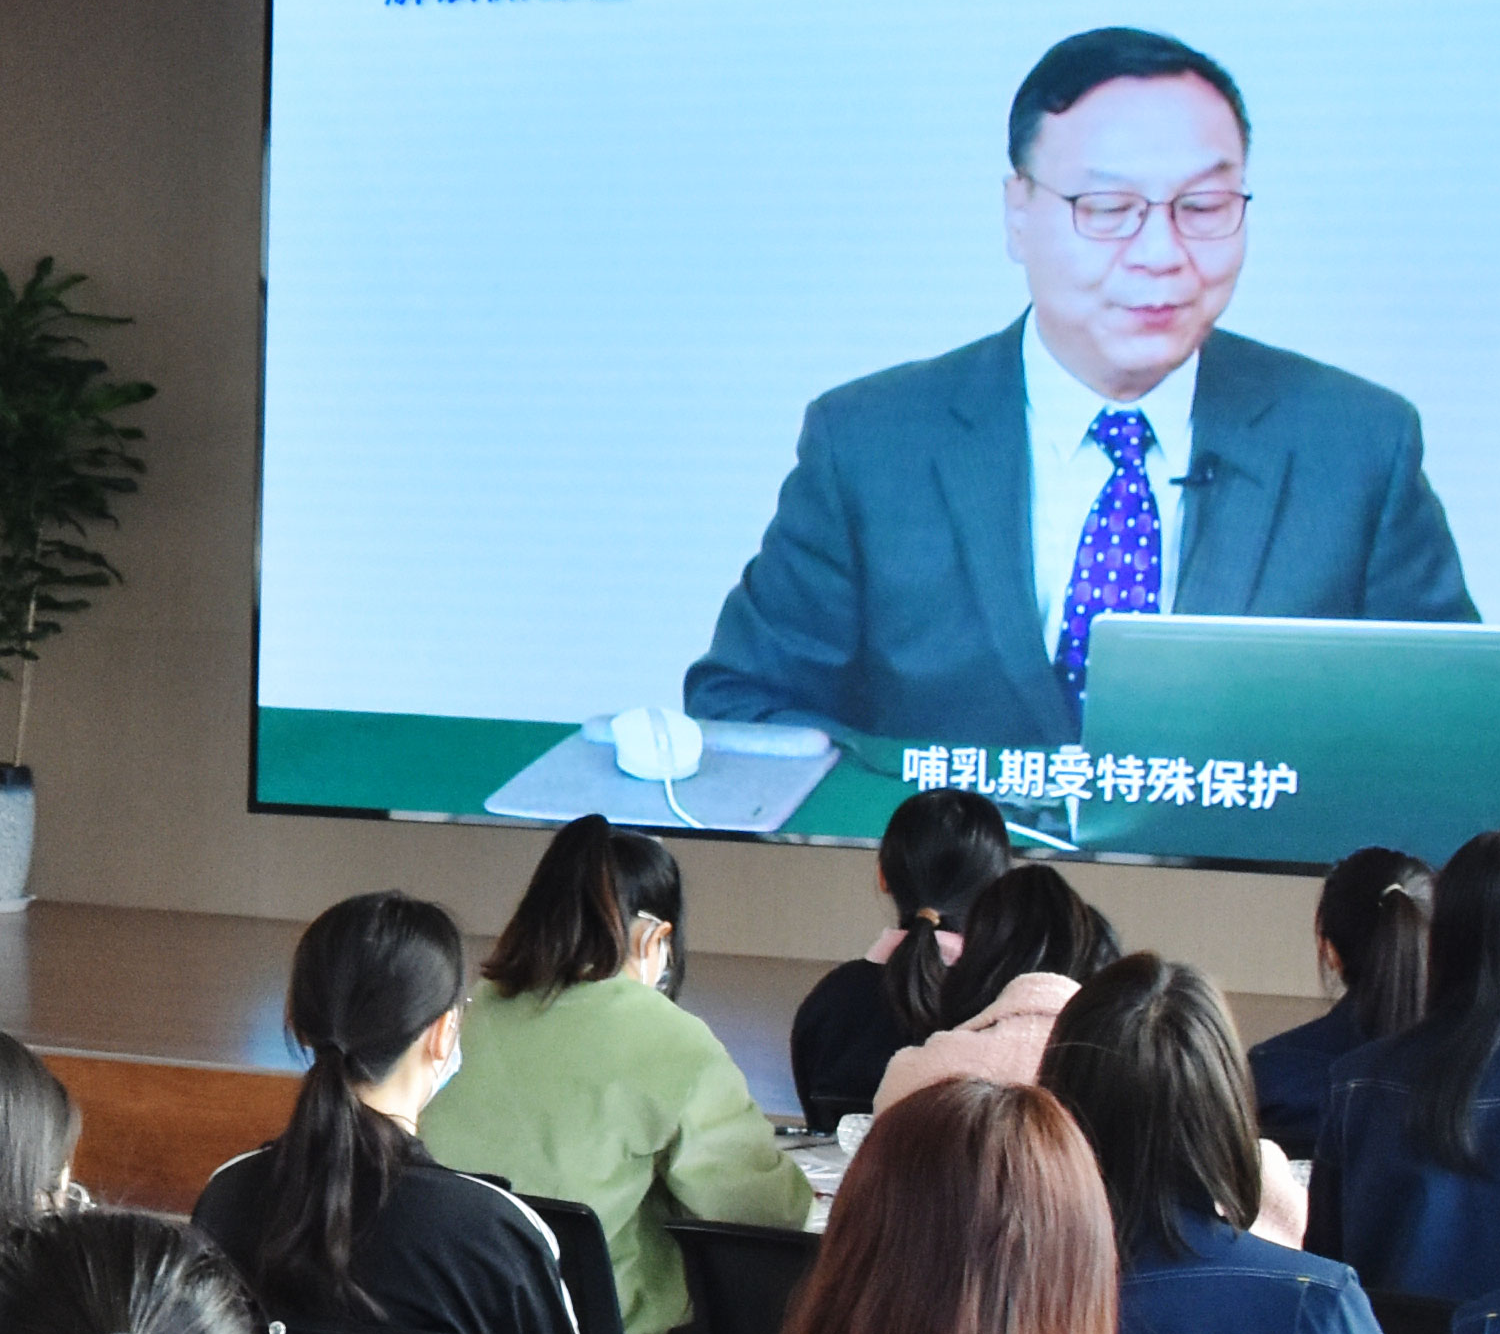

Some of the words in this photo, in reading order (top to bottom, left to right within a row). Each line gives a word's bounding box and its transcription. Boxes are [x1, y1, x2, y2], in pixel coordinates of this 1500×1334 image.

[902, 744, 1299, 810] 哺乳期受特殊保护
